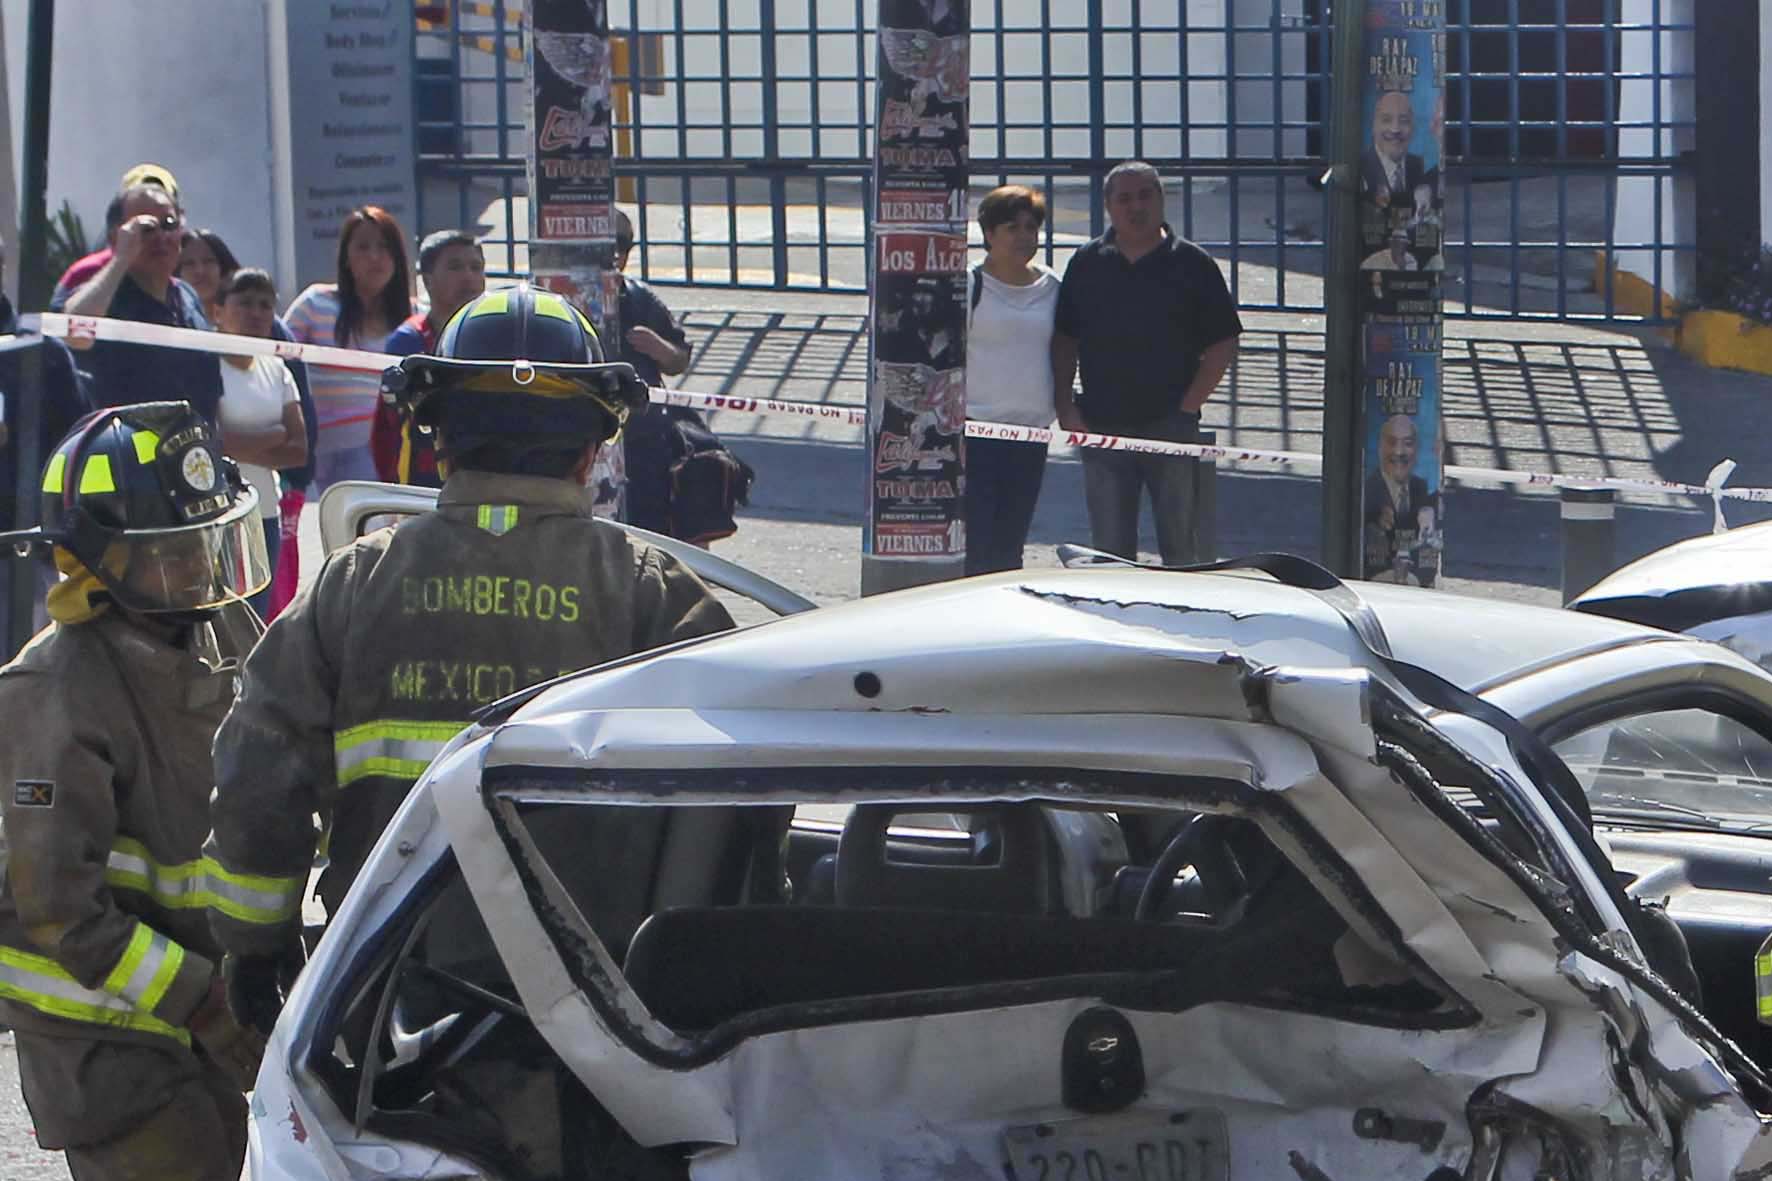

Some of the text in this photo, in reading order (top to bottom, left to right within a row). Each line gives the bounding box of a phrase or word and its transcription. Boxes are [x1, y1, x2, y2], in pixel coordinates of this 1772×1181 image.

[881, 202, 945, 221] VIERNES
[966, 424, 994, 438] PAS
[999, 427, 1019, 441] NO
[877, 534, 944, 553] VIERNES
[402, 575, 580, 622] BOMBEROS
[391, 661, 515, 704] MEXICO
